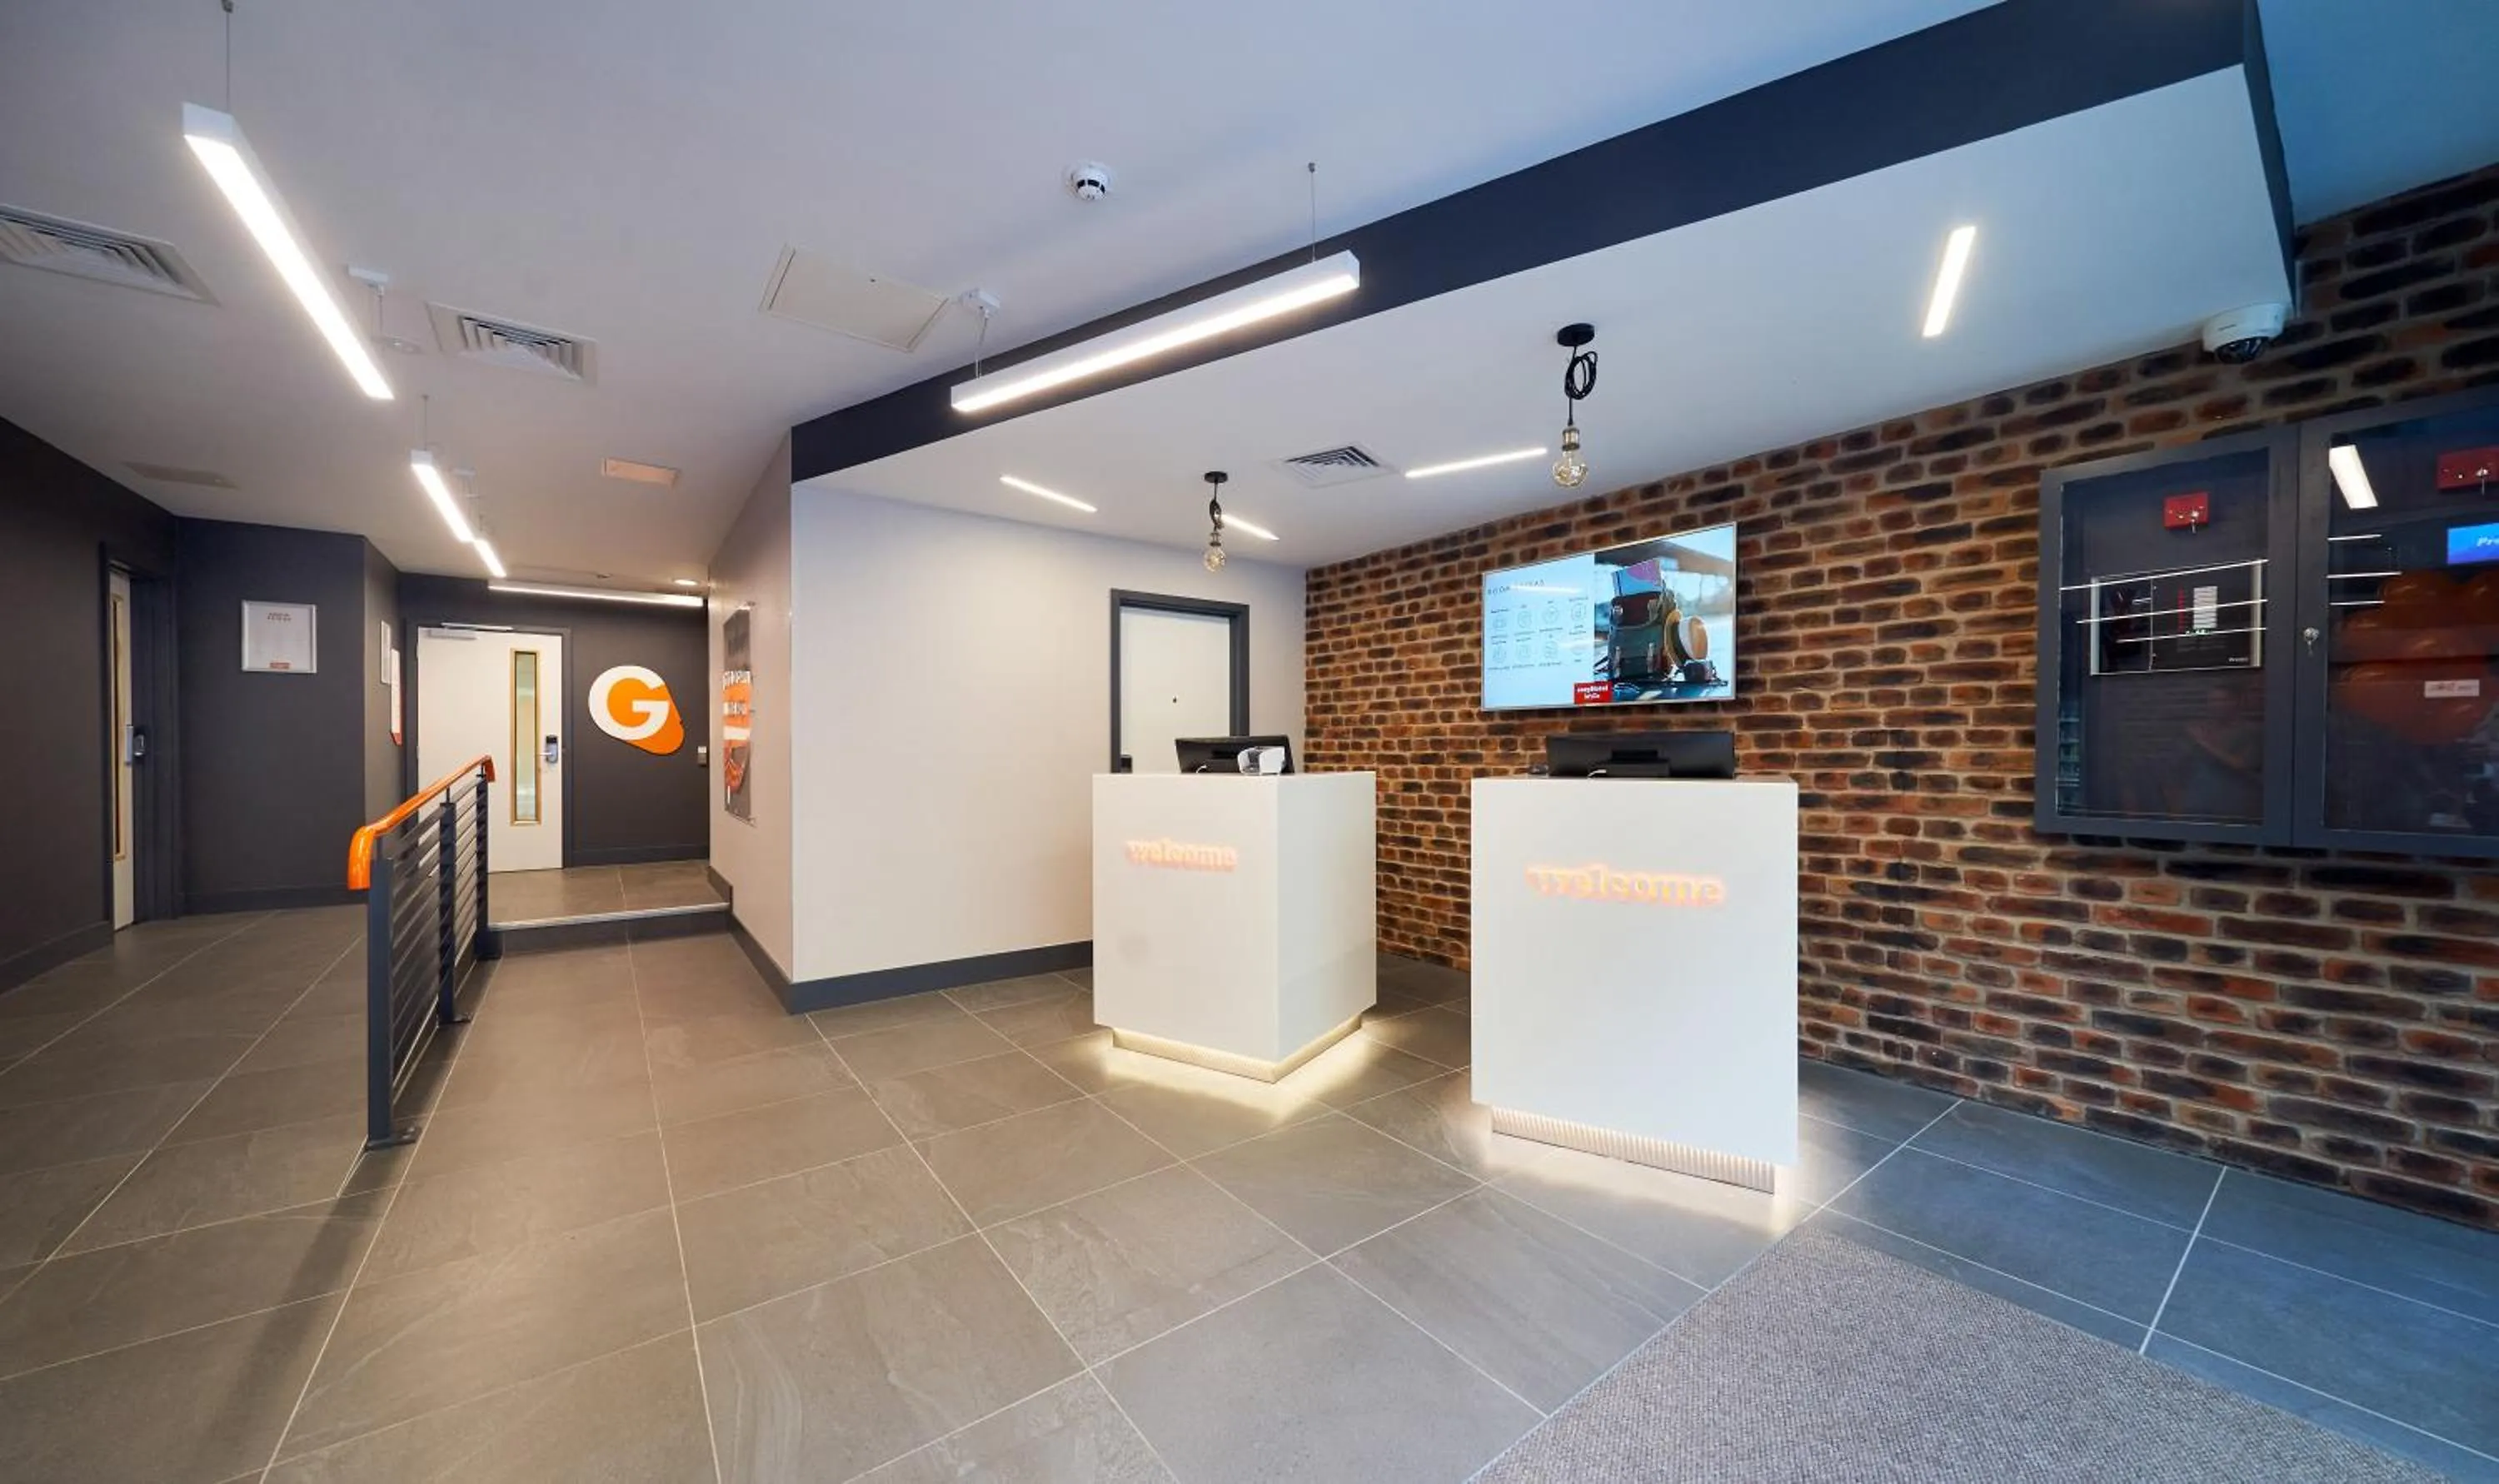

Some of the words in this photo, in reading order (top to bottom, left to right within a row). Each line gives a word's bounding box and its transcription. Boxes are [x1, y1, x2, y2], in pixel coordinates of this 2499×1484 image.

[588, 665, 670, 740] G
[1125, 837, 1239, 873] welcome
[1524, 864, 1727, 907] welcome
